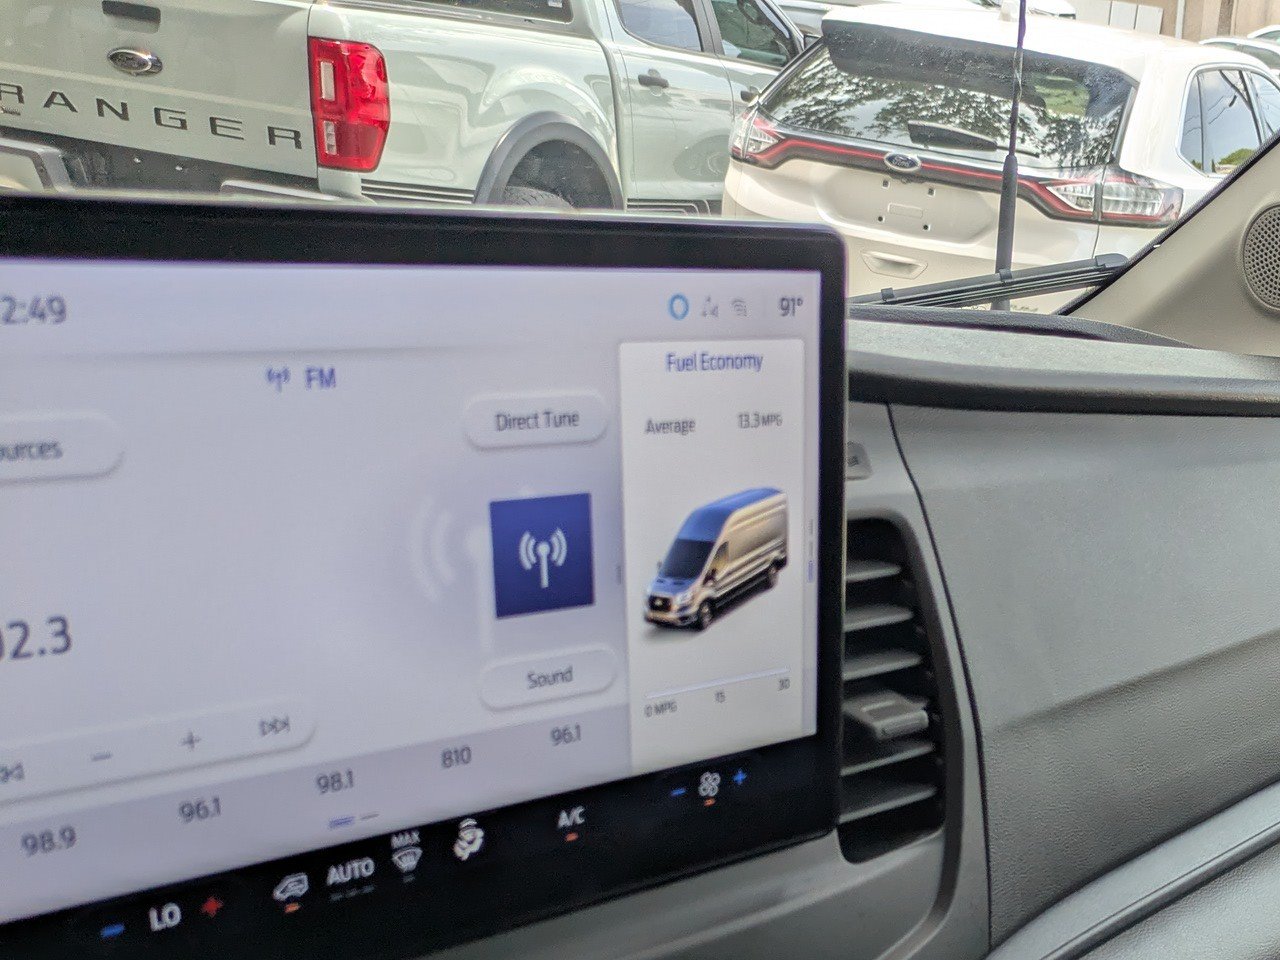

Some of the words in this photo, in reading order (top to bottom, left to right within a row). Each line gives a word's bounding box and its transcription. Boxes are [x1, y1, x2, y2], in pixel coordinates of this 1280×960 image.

[0, 82, 303, 149] RANGER
[666, 352, 697, 371] Fuel
[701, 352, 763, 372] Economy
[305, 367, 336, 389] FM
[495, 411, 540, 431] Direct
[543, 410, 580, 428] Tune
[645, 418, 696, 436] Average
[0, 615, 71, 660] 2.3
[527, 666, 574, 689] Sound
[551, 724, 582, 746] 96.1
[441, 746, 472, 768] 810
[316, 769, 354, 794] 98.1
[179, 797, 221, 823] 96.1
[557, 805, 586, 829] A/C
[21, 824, 77, 857] 98.9
[391, 830, 421, 849] MAX
[327, 857, 375, 886] AUTO
[149, 902, 182, 931] LO
